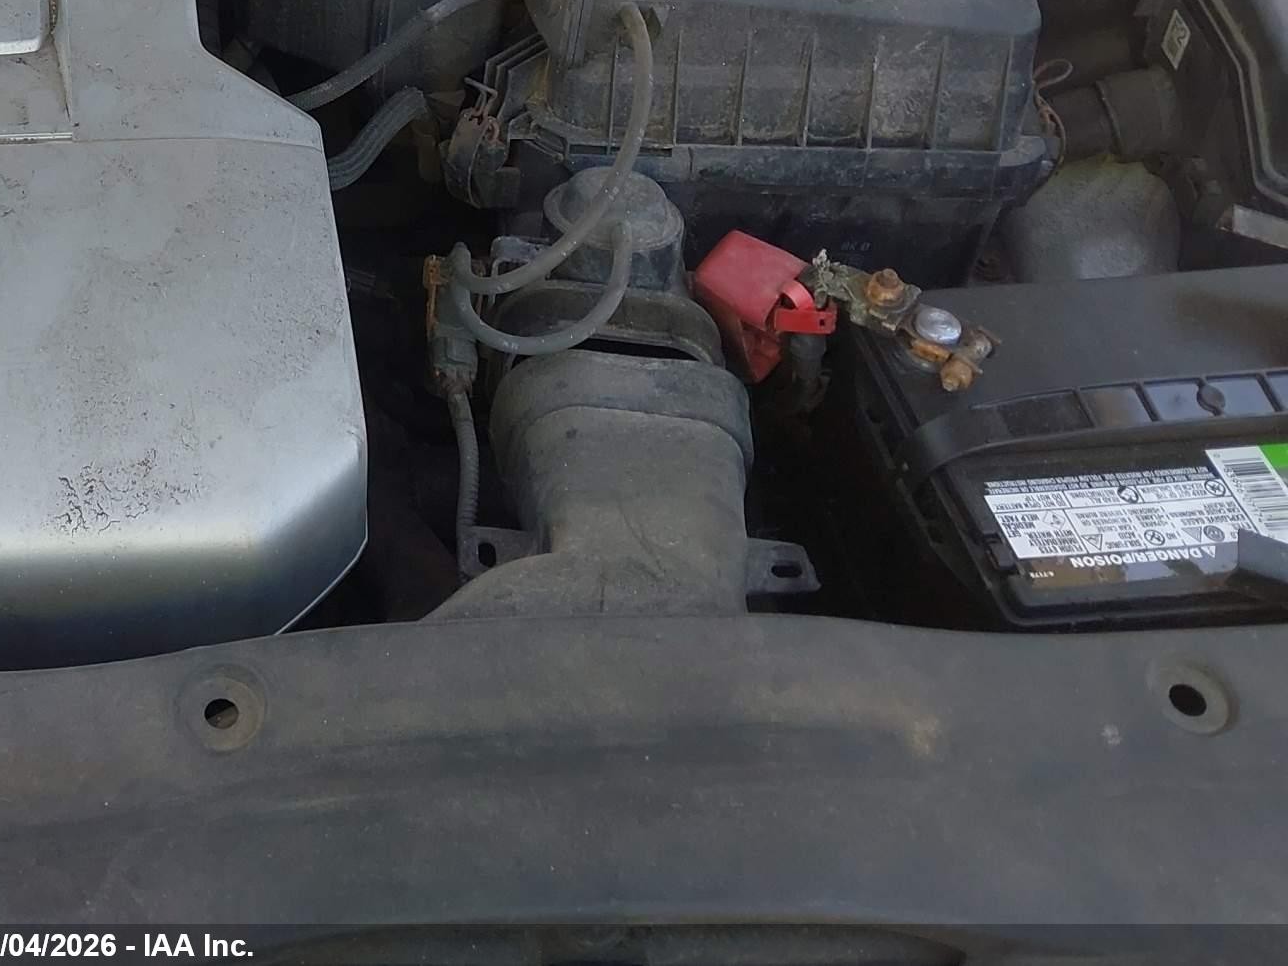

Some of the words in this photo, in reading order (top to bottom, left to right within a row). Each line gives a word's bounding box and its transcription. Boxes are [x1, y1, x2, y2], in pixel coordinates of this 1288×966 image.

[1021, 514, 1040, 522] HELP
[1001, 522, 1036, 530] MEDICAL
[1005, 530, 1022, 538] GET
[1054, 530, 1073, 538] WITH
[1070, 547, 1203, 568] DANGER/POISON
